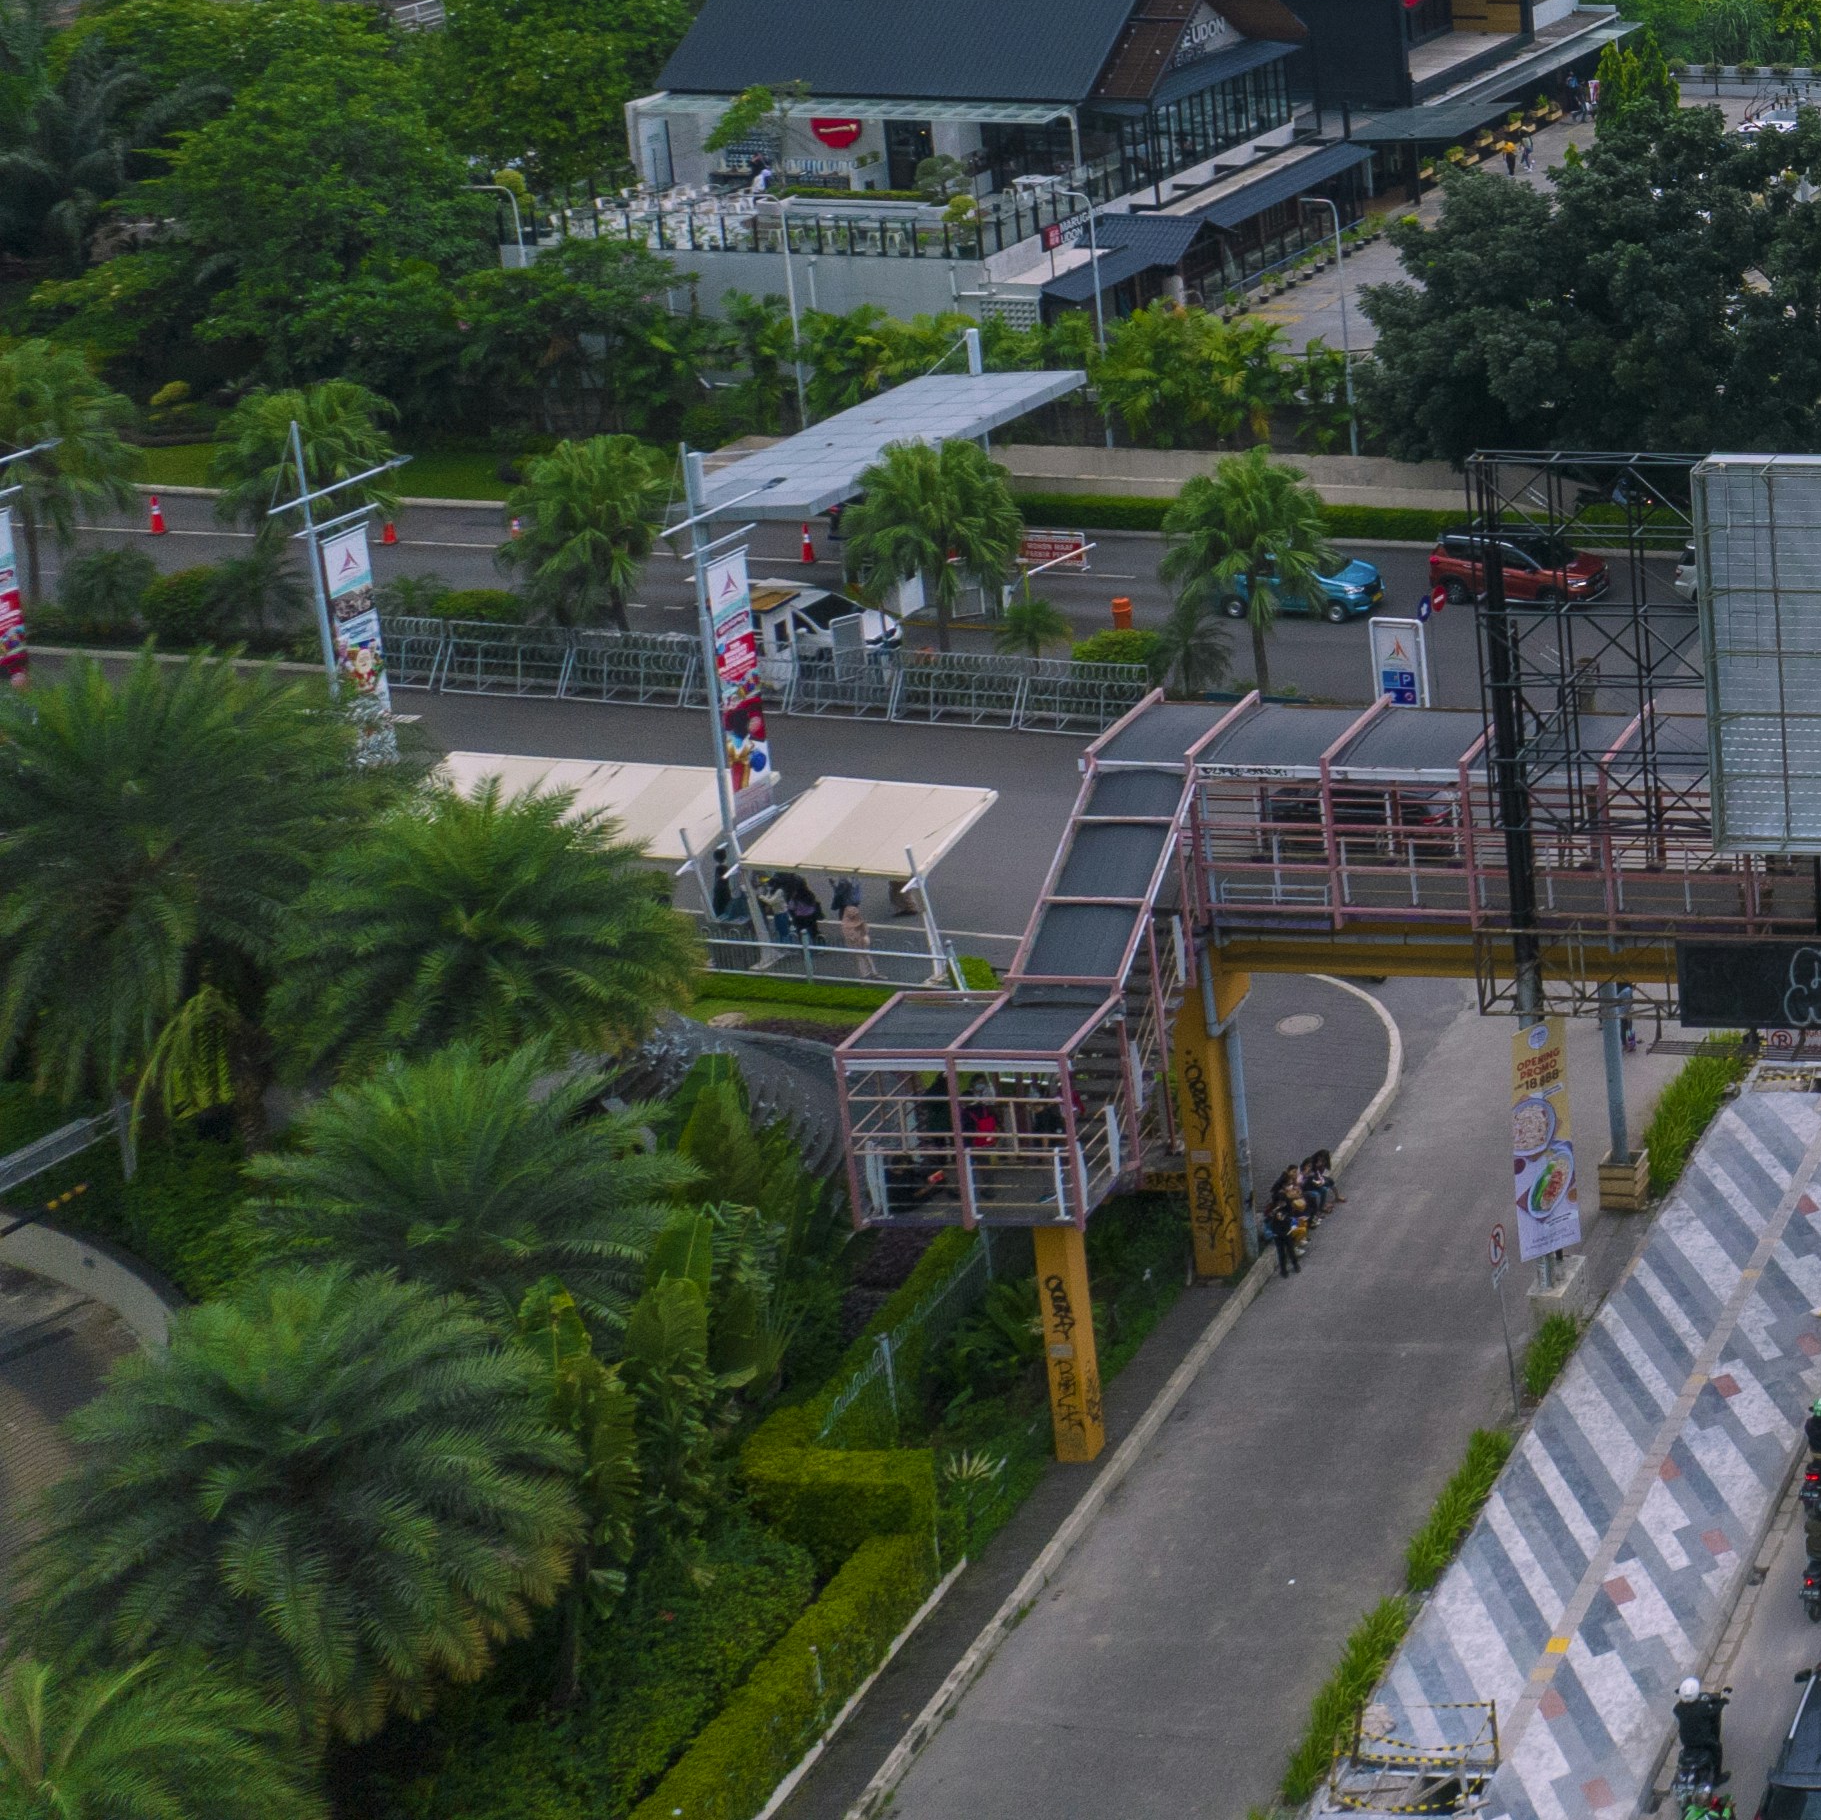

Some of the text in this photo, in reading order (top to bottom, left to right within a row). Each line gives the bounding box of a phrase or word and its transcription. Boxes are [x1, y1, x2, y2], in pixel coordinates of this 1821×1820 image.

[1192, 16, 1226, 43] UDON
[1516, 1046, 1560, 1072] OPENING
[1520, 1059, 1557, 1080] PROMO
